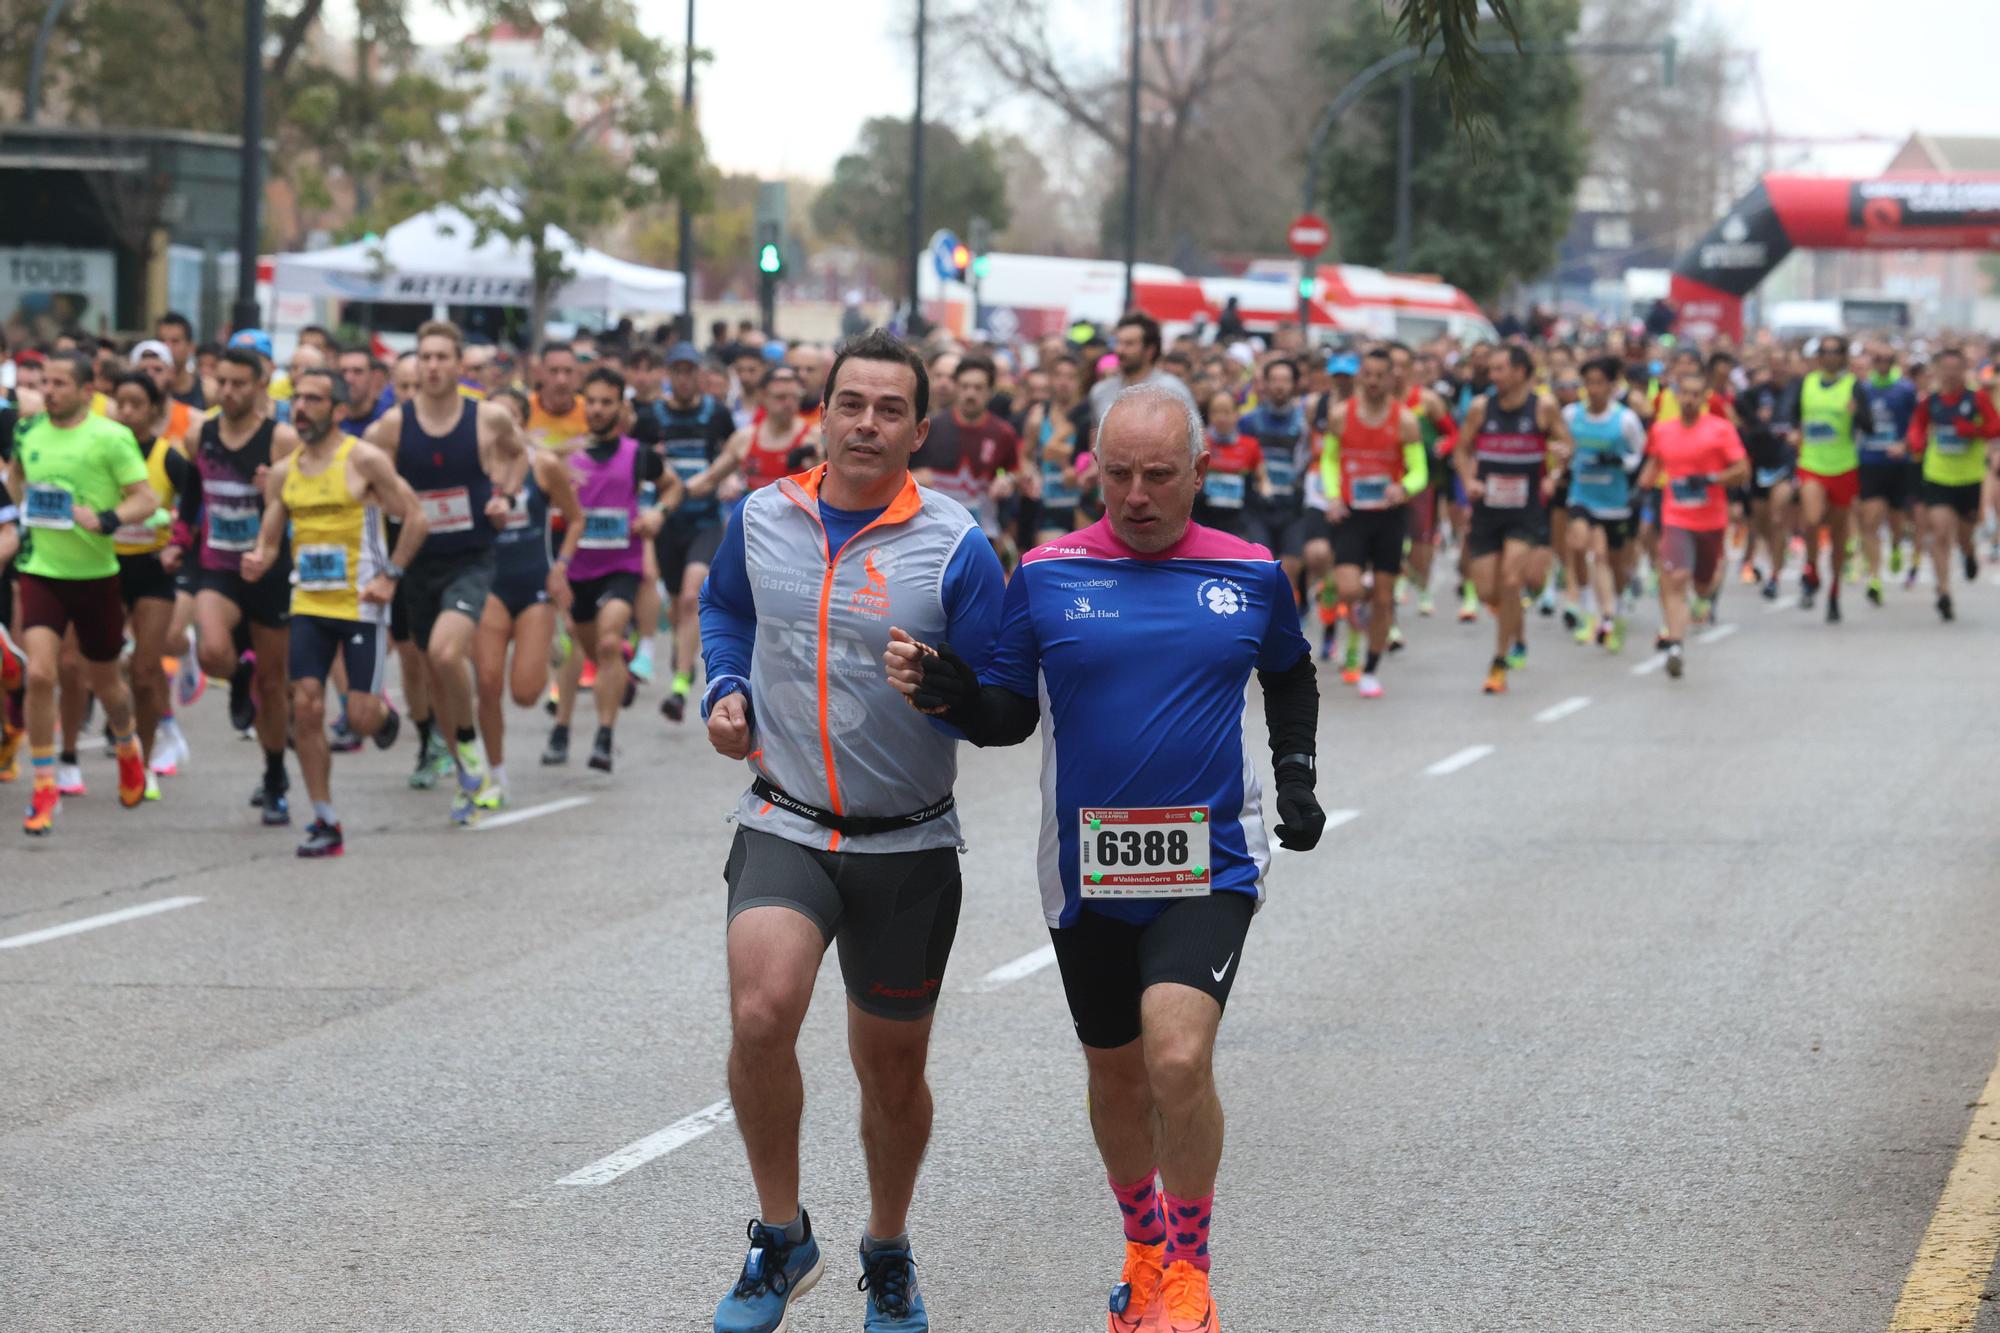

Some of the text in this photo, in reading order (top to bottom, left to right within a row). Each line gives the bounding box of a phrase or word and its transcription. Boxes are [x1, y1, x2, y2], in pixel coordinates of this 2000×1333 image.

[1061, 579, 1118, 589] momadesign
[1065, 609, 1119, 621] Natural Hand
[780, 797, 820, 818] OUTPACE
[1097, 830, 1188, 866] 6388
[1113, 873, 1170, 883] #ValènciaCorre
